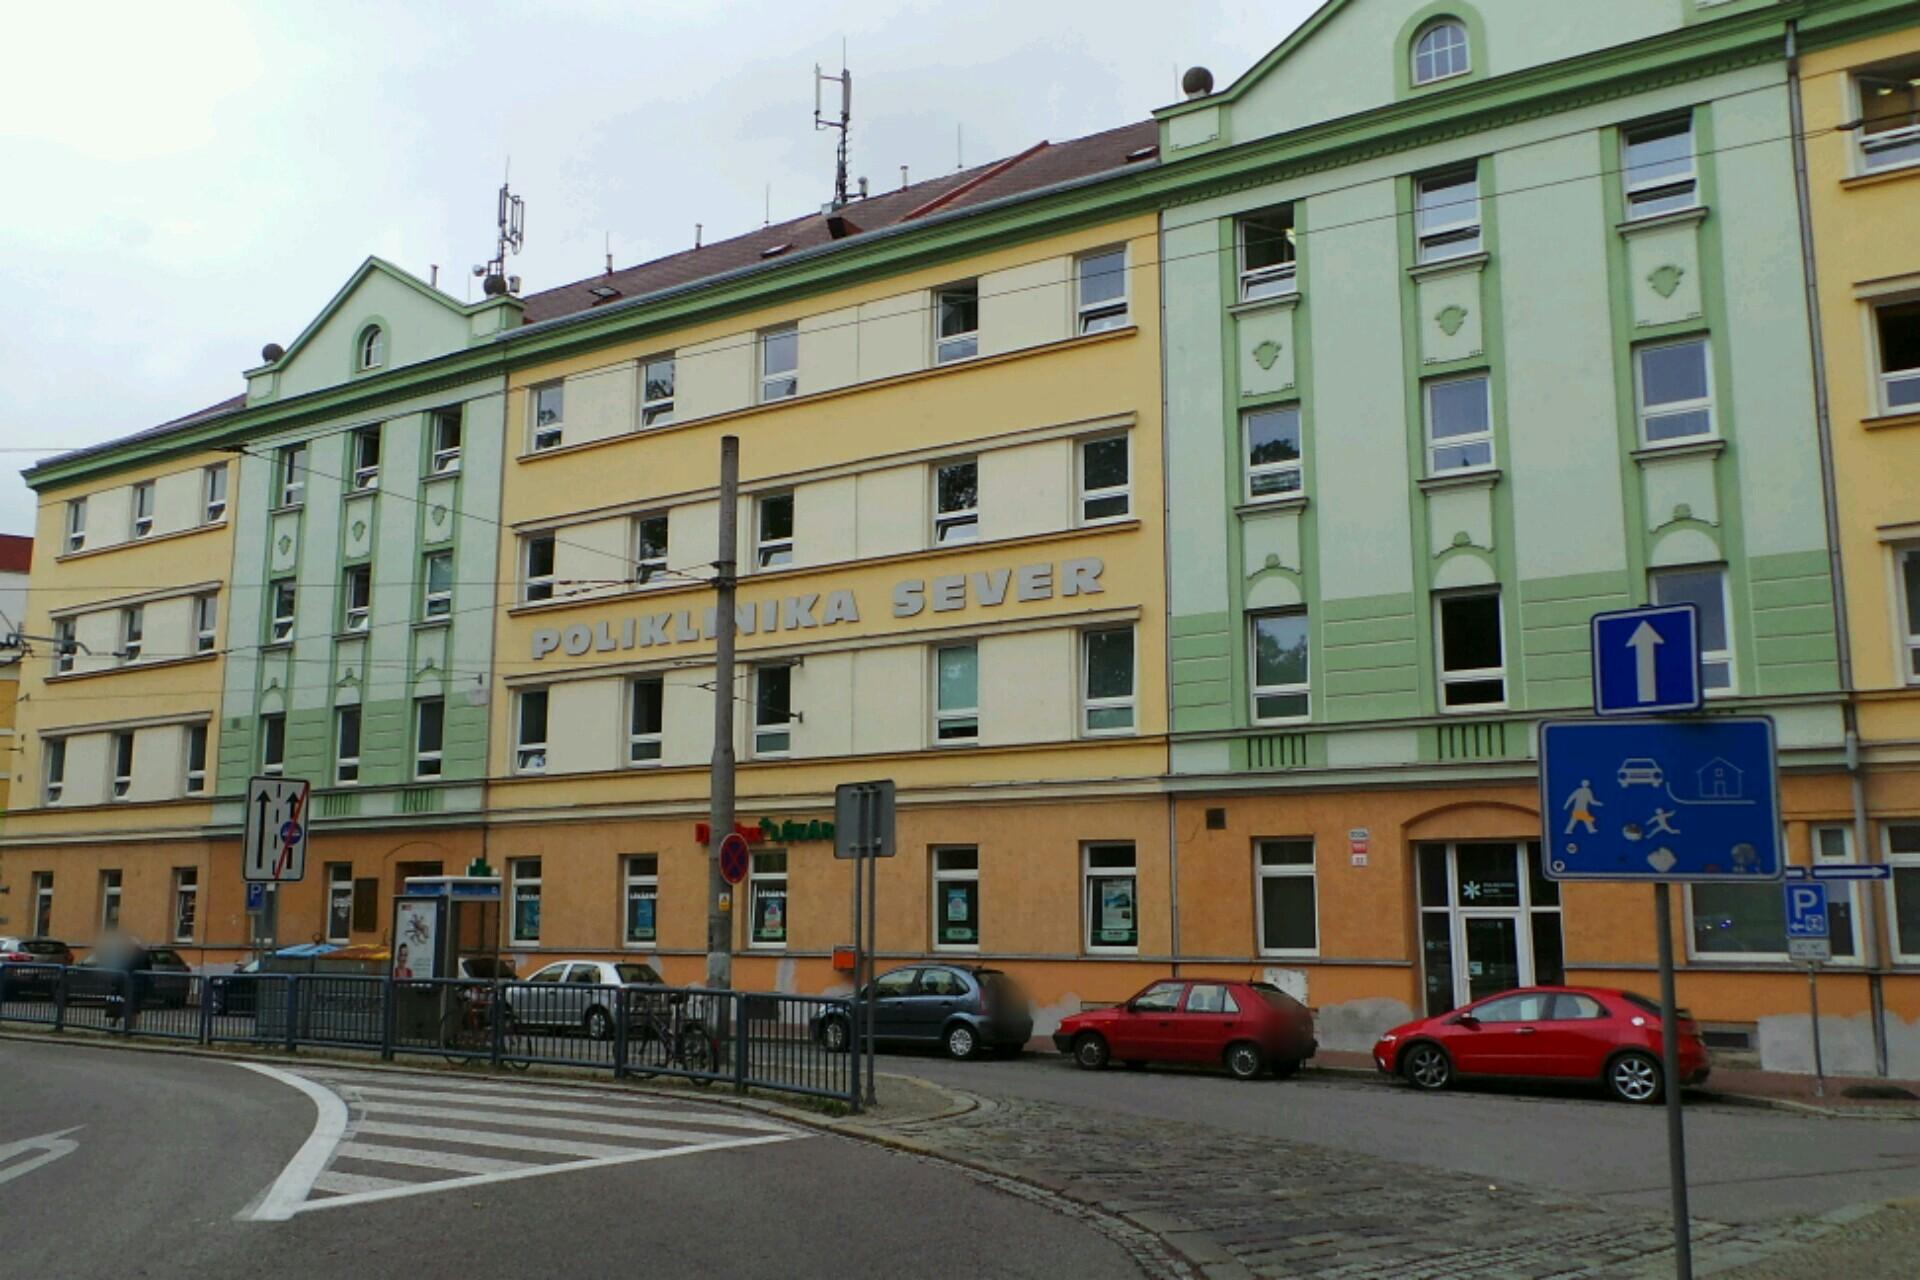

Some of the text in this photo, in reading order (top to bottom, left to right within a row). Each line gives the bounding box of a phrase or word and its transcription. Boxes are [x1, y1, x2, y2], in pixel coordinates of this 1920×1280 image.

[531, 557, 1105, 660] POLIKLINIKA SEVER
[250, 884, 262, 900] P
[1793, 889, 1818, 919] P
